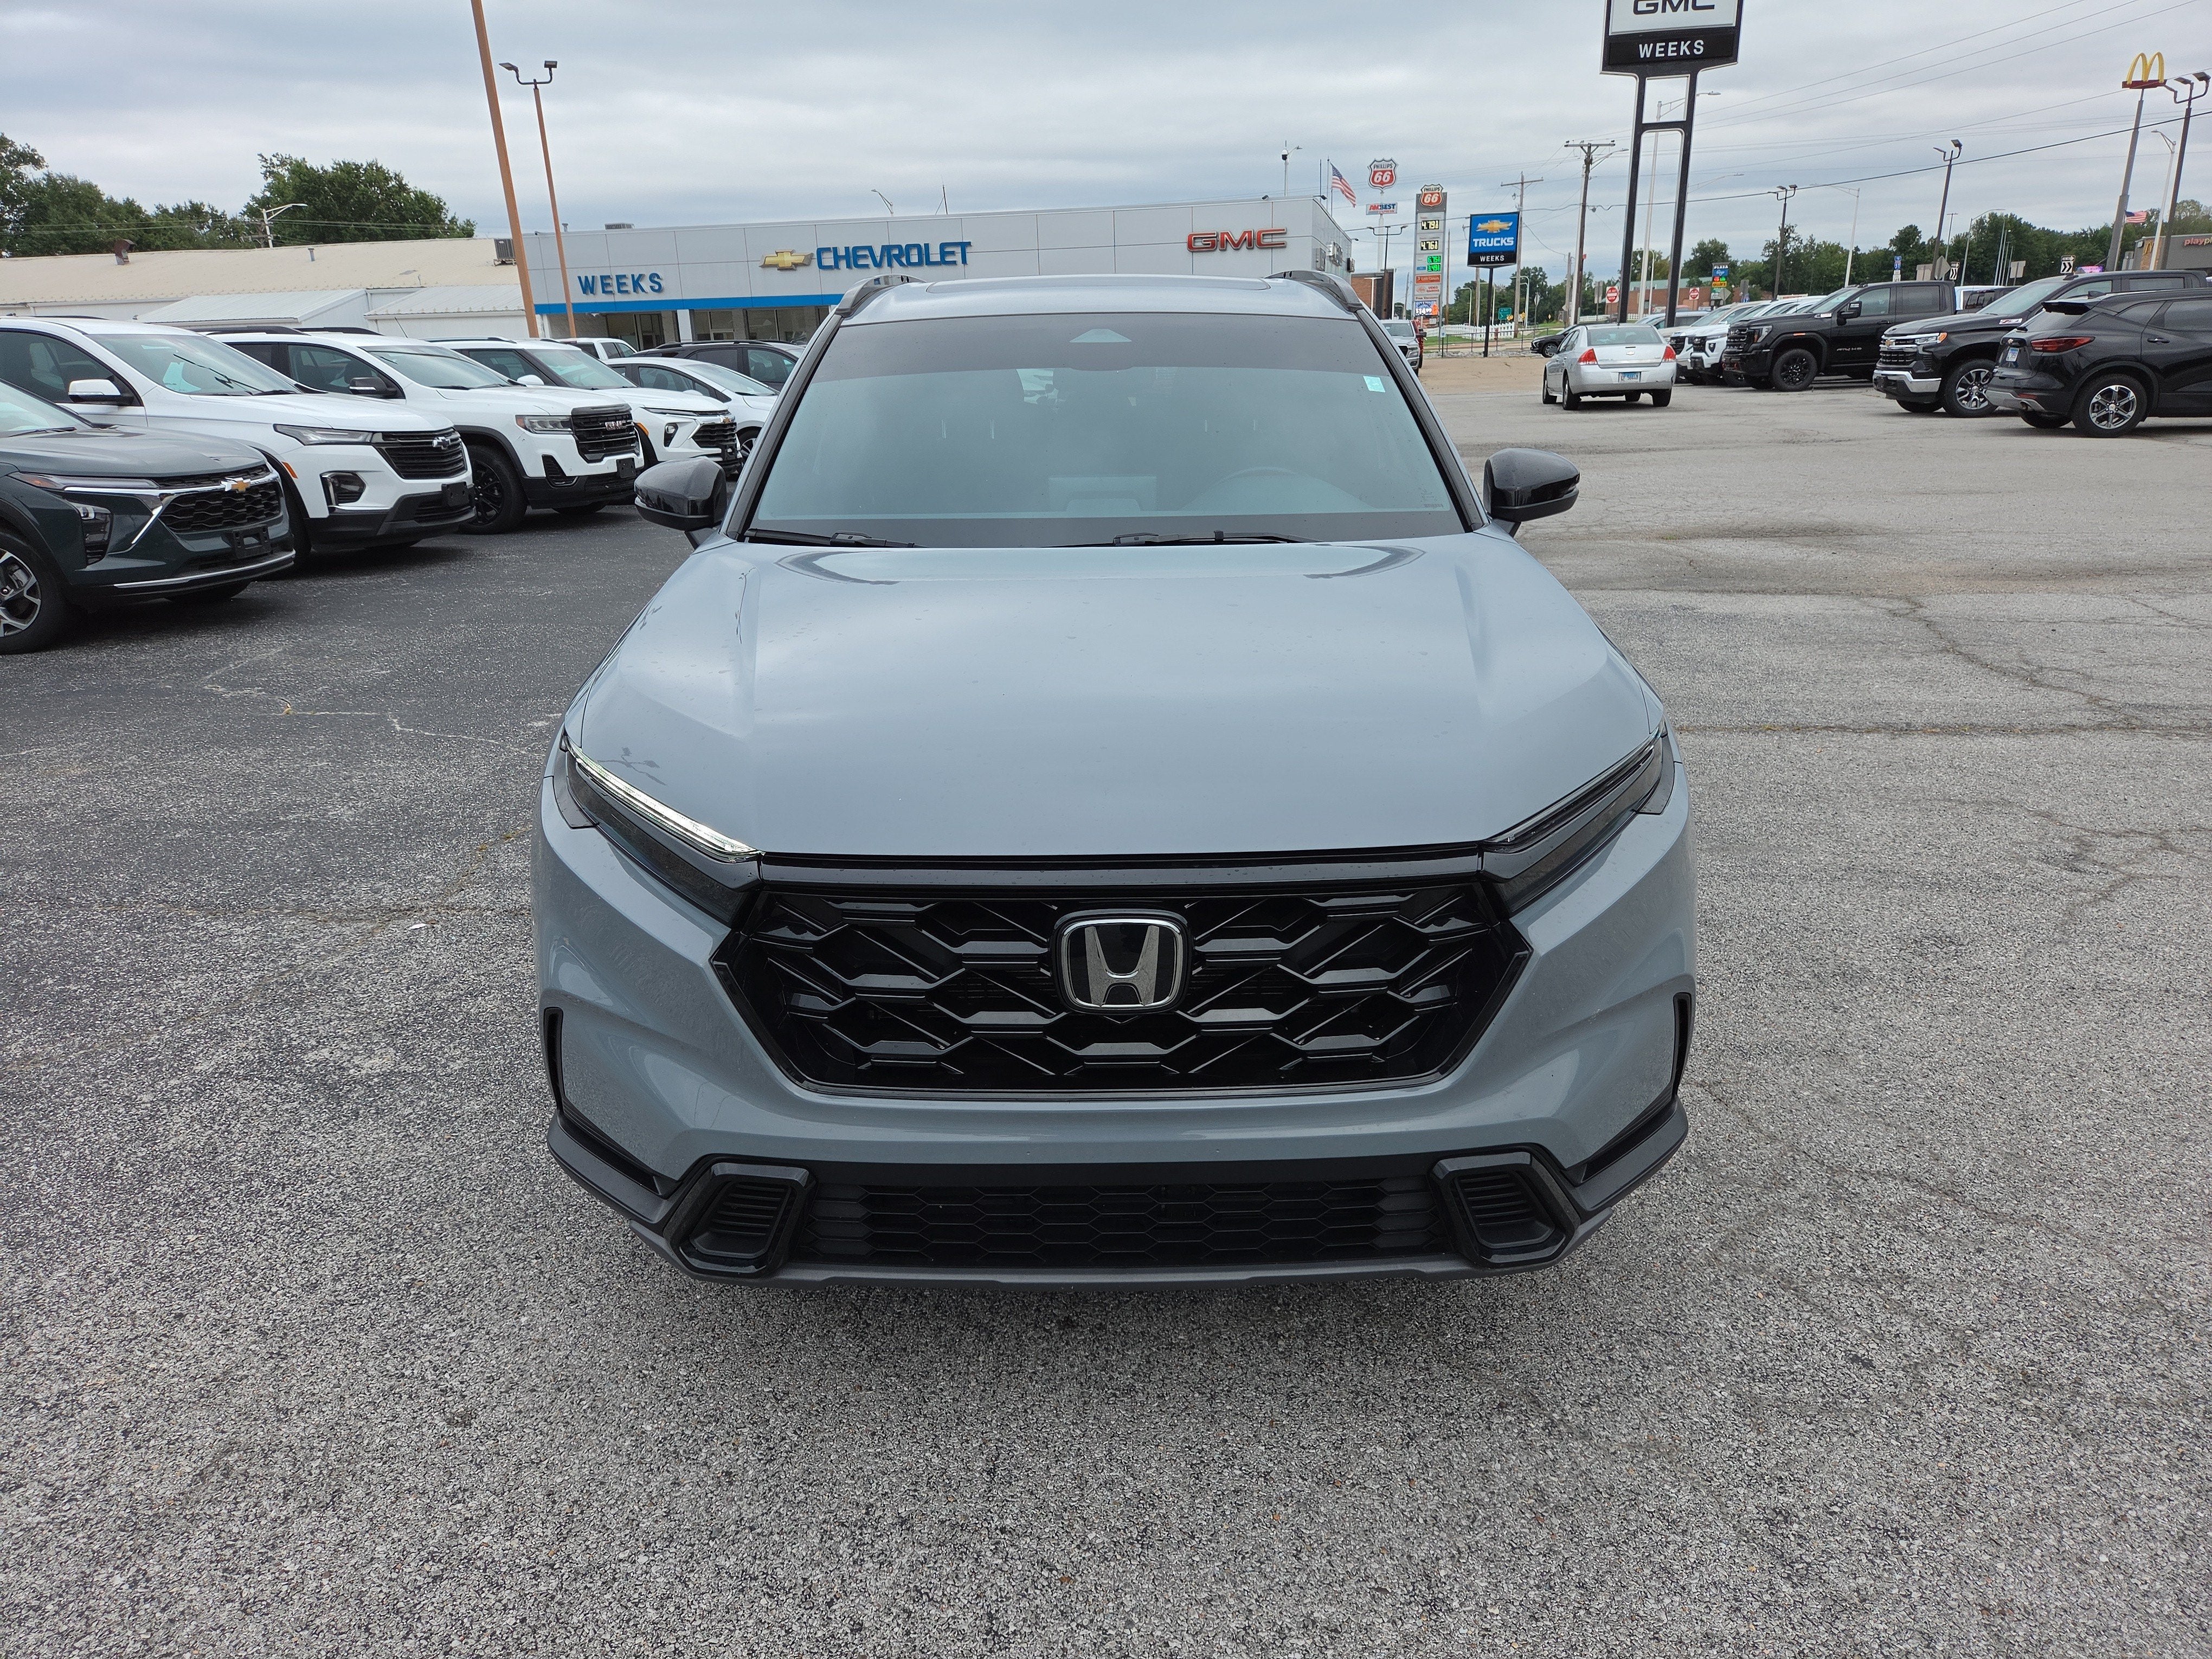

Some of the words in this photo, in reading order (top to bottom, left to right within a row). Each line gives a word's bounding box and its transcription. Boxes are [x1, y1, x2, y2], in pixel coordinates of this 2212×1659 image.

[1633, 0, 1715, 15] GMC
[1639, 40, 1704, 58] WEEKS
[1374, 171, 1392, 183] 66
[1424, 193, 1439, 203] 66
[1186, 227, 1287, 252] GMC
[1473, 237, 1514, 247] TRUCKS
[816, 241, 972, 271] CHEVROLET
[577, 273, 664, 295] WEEKS
[605, 420, 627, 431] GMC
